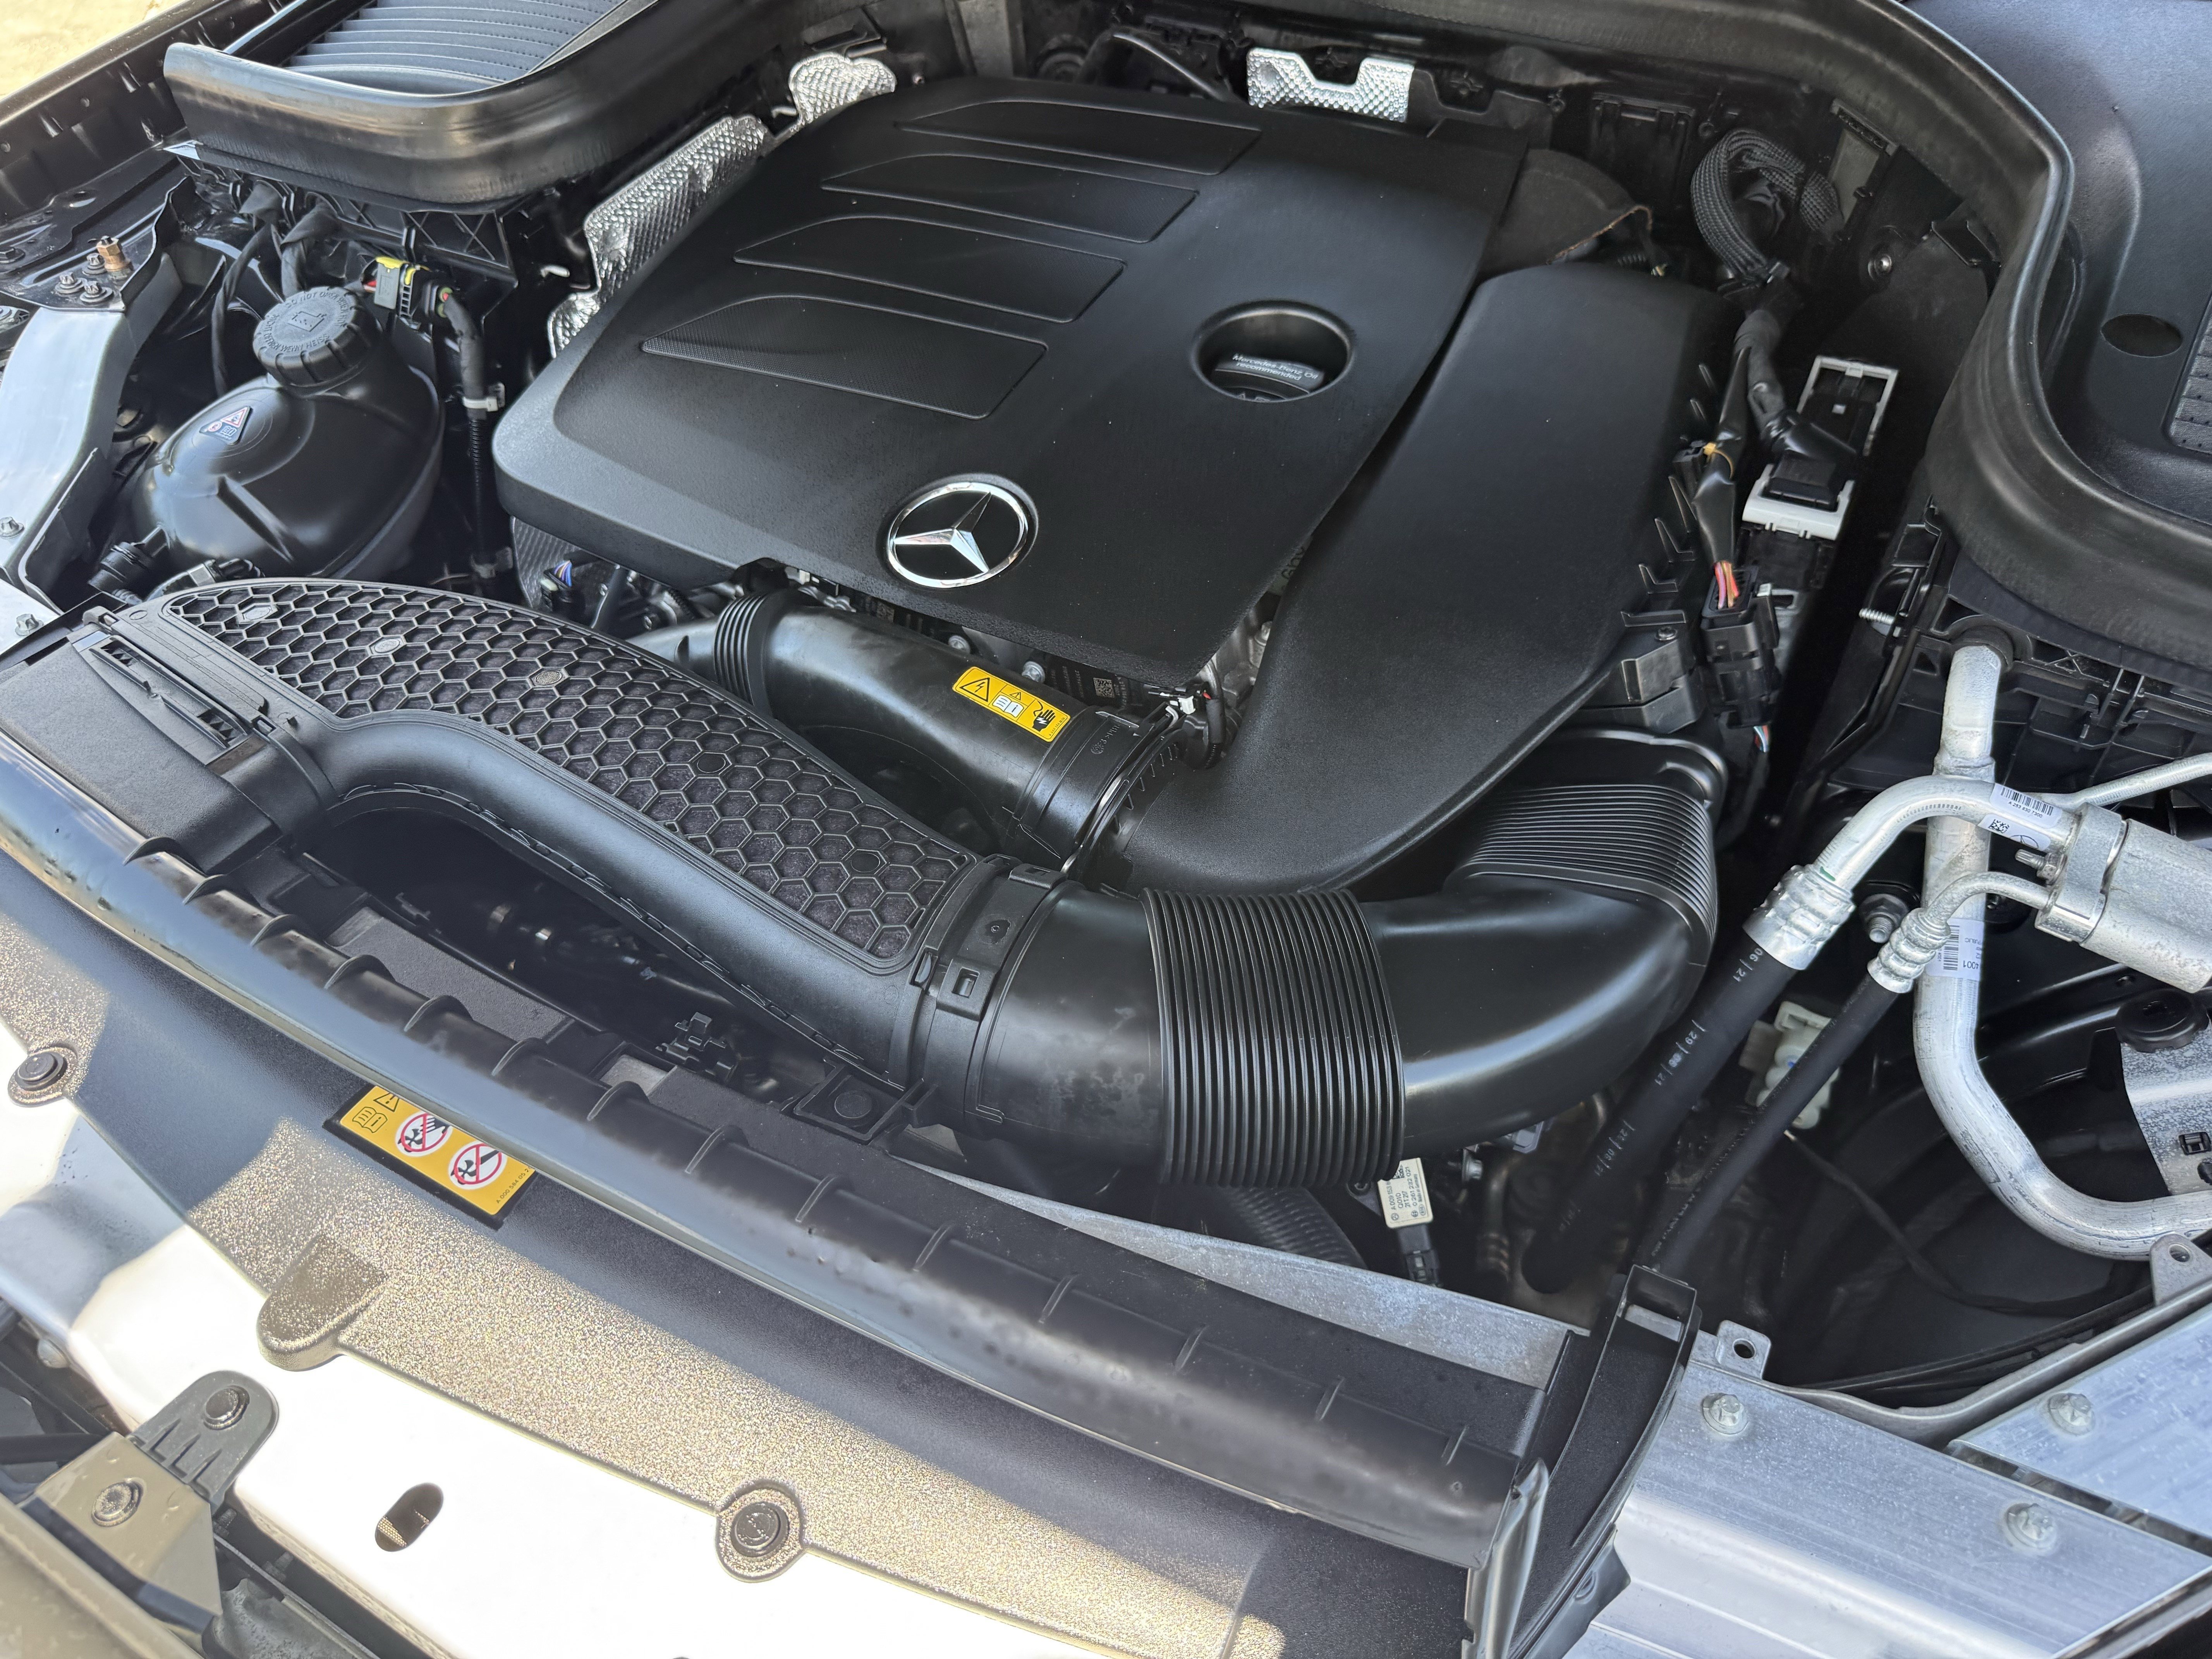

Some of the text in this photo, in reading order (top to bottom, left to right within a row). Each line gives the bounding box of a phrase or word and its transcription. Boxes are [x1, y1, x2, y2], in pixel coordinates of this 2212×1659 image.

[1233, 354, 1318, 379] Mercedes-Benz Oil
[1236, 362, 1302, 380] recommended
[1749, 948, 1763, 962] 06
[500, 1189, 510, 1199] 000
[509, 1179, 519, 1189] 584
